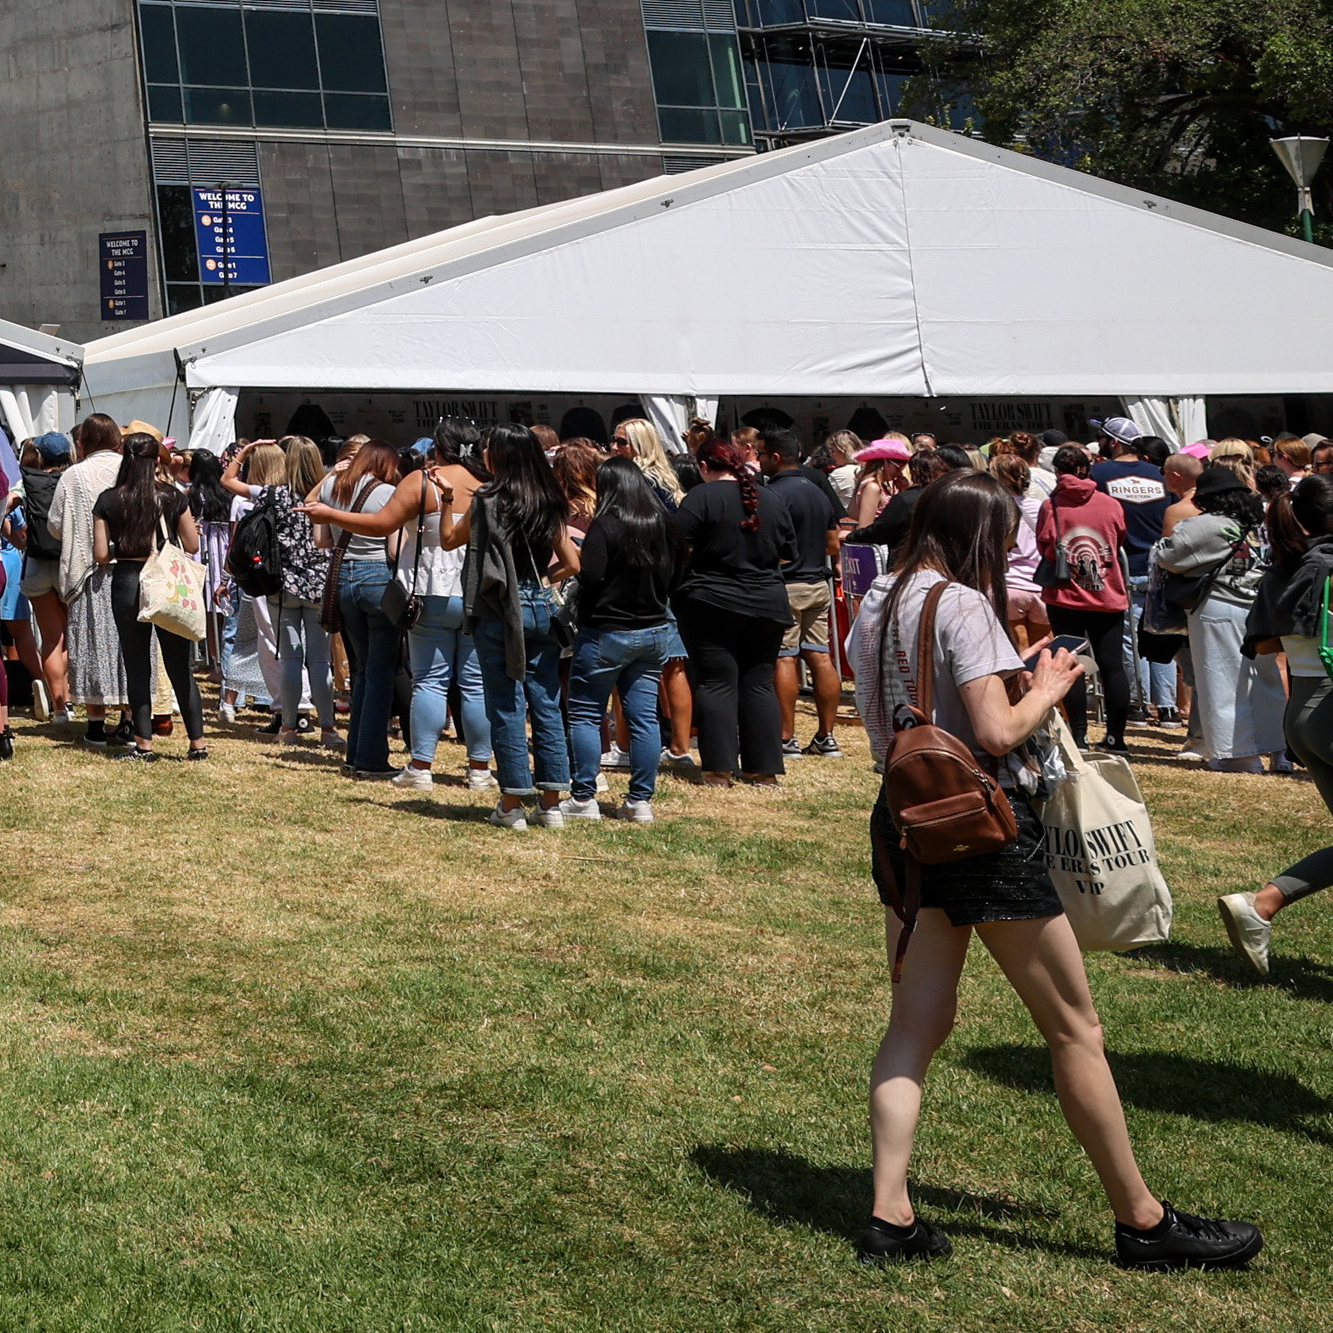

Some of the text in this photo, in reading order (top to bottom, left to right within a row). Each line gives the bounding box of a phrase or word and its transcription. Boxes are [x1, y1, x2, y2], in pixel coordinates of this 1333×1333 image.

[228, 202, 247, 210] MCG
[242, 194, 254, 202] TO
[106, 240, 130, 248] WELCOME
[413, 401, 459, 418] TAYLOR
[461, 401, 497, 418] SWIFT
[970, 402, 1015, 420] TAYLOR
[1017, 403, 1051, 420] SWIFT
[1111, 486, 1162, 494] RINGERS
[895, 650, 910, 674] RED
[1084, 819, 1143, 859] SWIFT
[1102, 849, 1150, 872] TOUR
[1076, 879, 1105, 896] VIP
